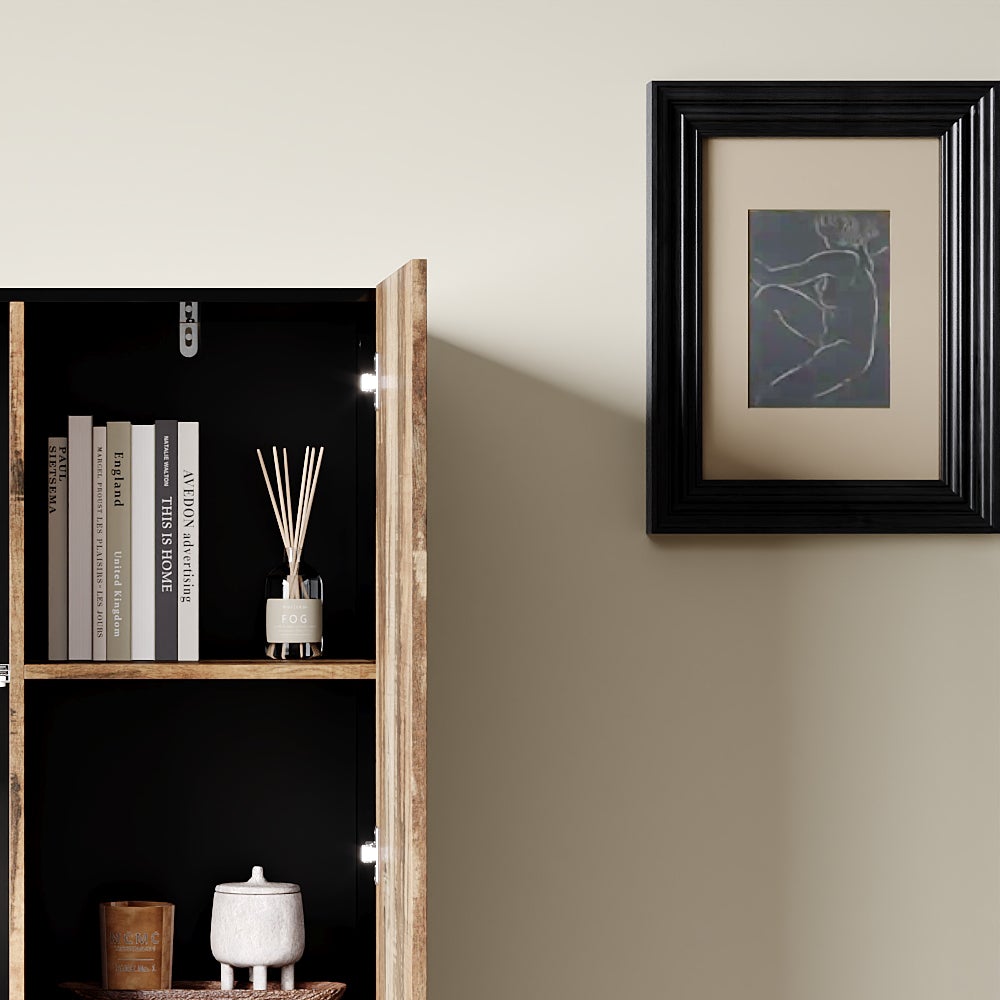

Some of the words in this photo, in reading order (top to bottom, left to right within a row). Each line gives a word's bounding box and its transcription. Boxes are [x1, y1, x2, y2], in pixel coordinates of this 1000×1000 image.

[49, 445, 57, 514] SIETSEMA
[59, 447, 67, 482] PAUL
[111, 452, 124, 507] England
[161, 496, 173, 529] THIS
[183, 469, 194, 528] AVEDON
[161, 533, 173, 546] IS
[114, 551, 122, 586] United
[161, 550, 173, 593] HOME
[180, 533, 194, 603] advertising
[112, 590, 122, 637] Kingdom
[281, 614, 308, 624] FOG
